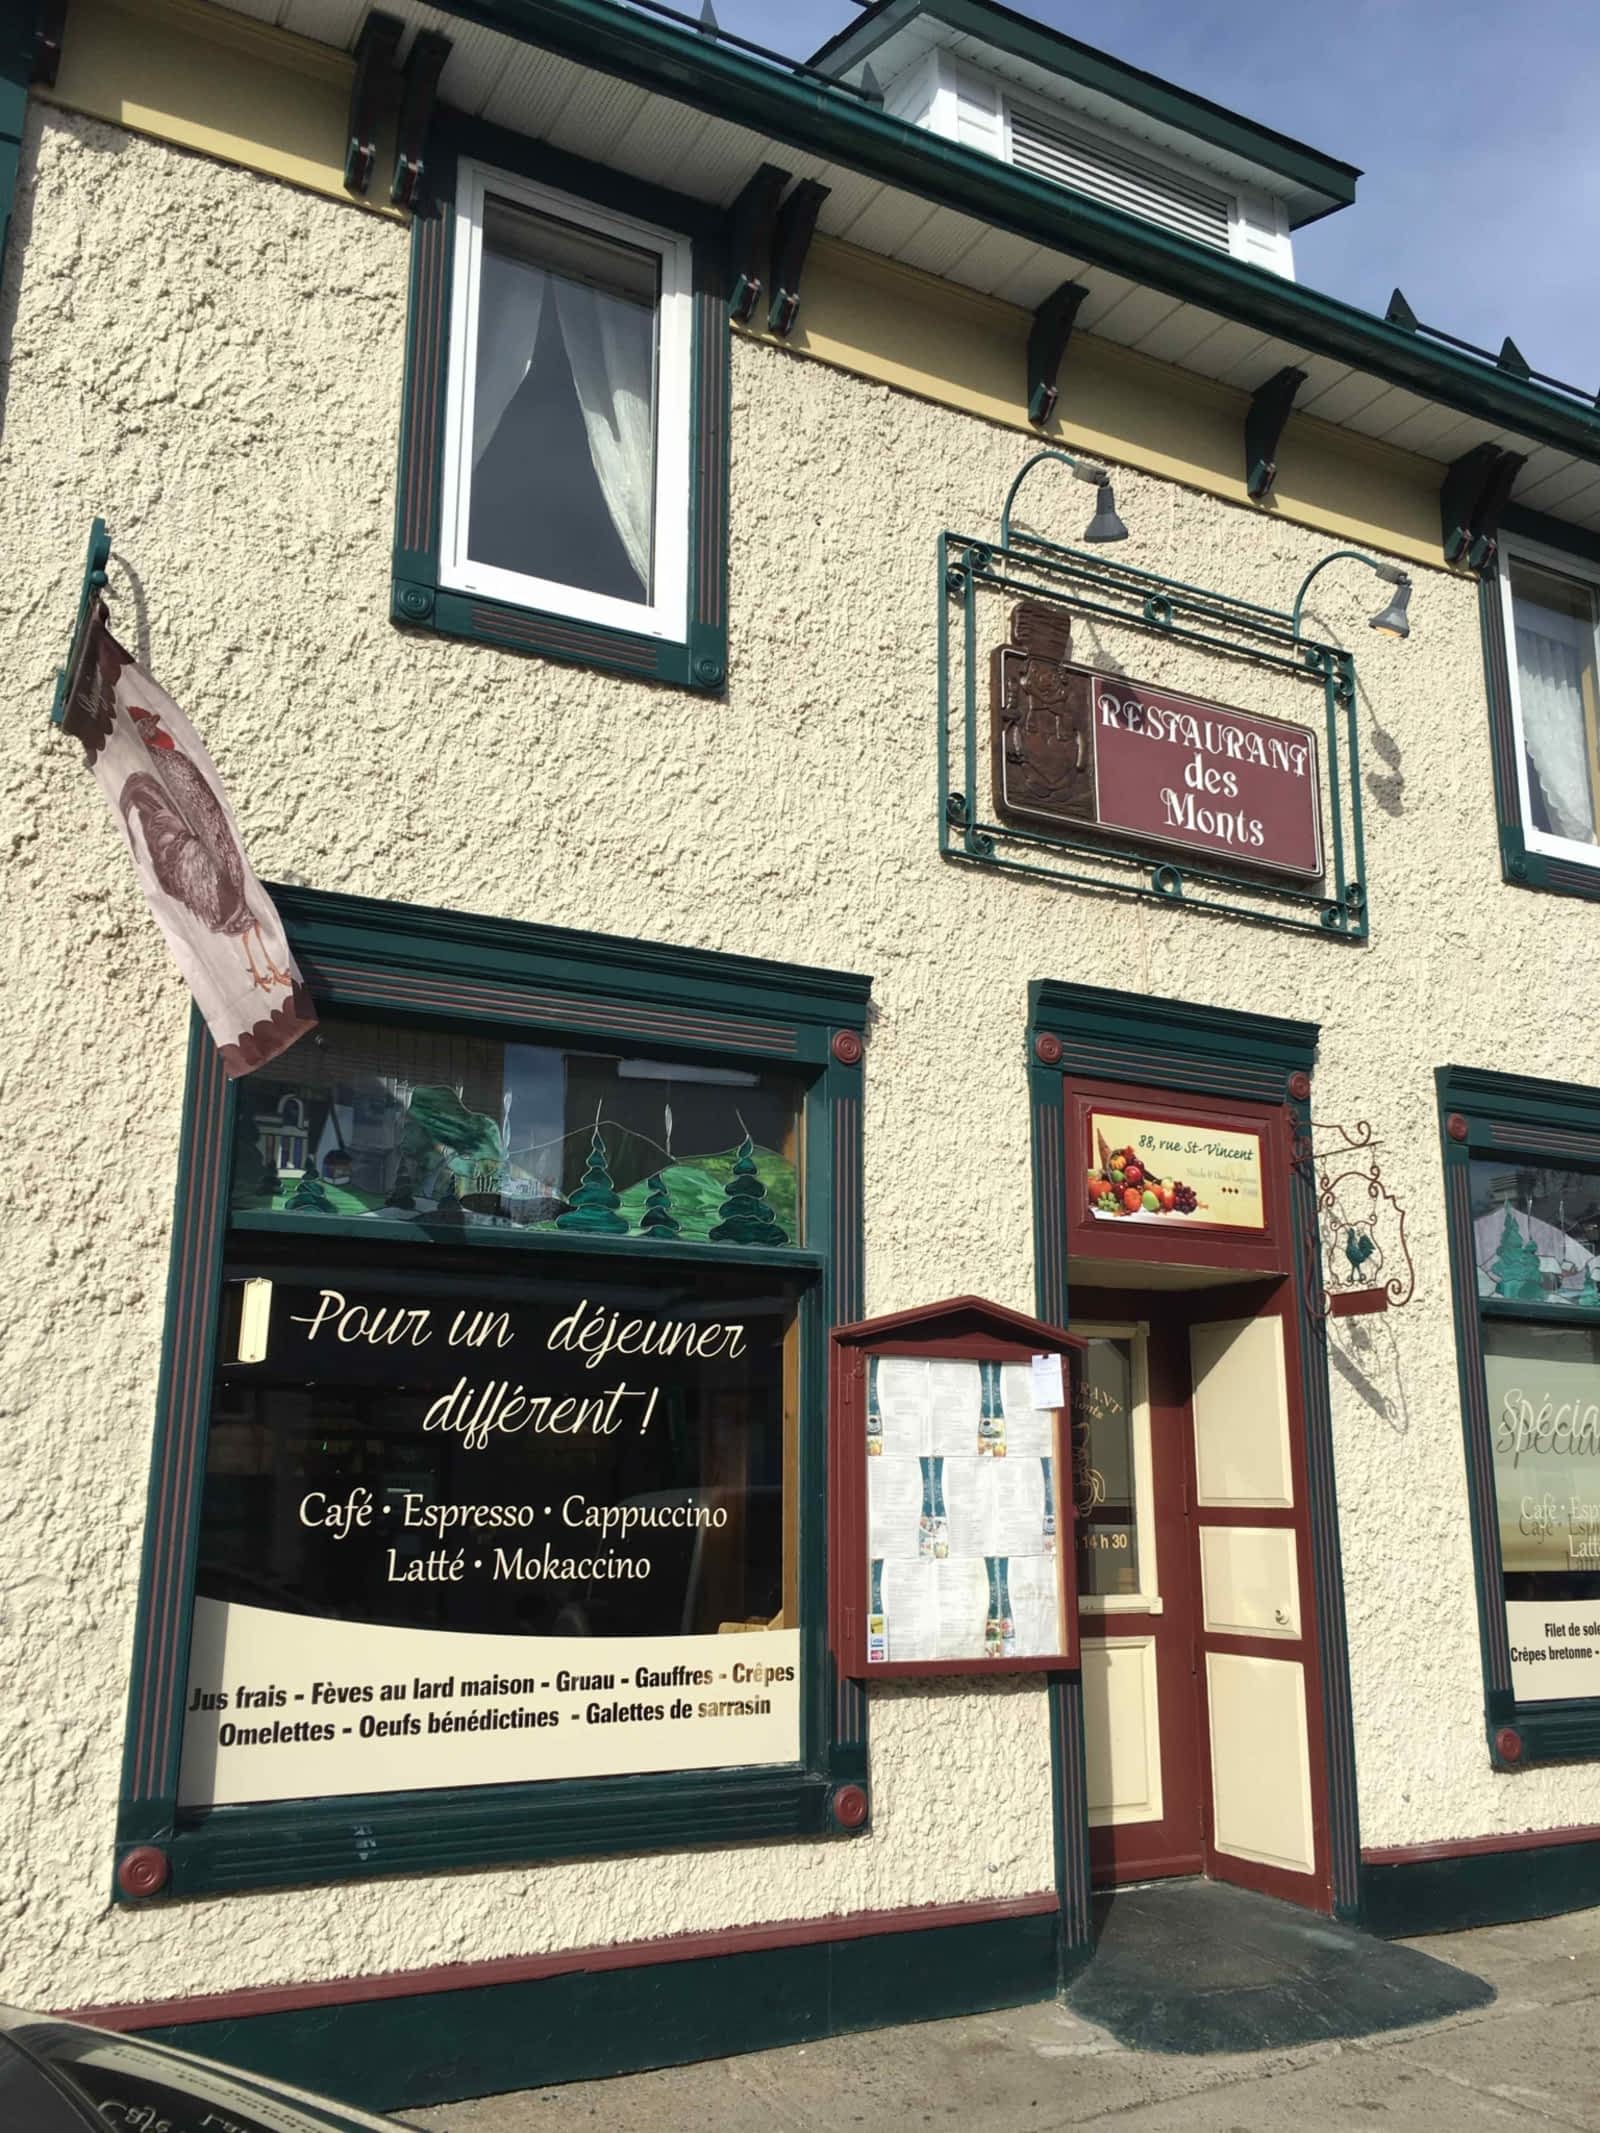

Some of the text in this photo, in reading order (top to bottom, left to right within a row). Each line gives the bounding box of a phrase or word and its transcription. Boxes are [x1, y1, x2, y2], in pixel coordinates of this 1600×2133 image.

[1098, 694, 1308, 777] RESTAURANT
[1184, 753, 1238, 798] des
[1160, 788, 1264, 847] Monts
[1160, 1139, 1182, 1152] rue
[1184, 1140, 1255, 1160] St-Vincent
[290, 1290, 746, 1368] Pour un déjeuner
[300, 1487, 372, 1540] Café
[403, 1494, 534, 1538] Espresso
[562, 1495, 728, 1542] Cappuccino
[1568, 1495, 1600, 1529] Esp
[1112, 1533, 1128, 1549] 30
[1568, 1534, 1600, 1557] Latt
[387, 1547, 465, 1582] Latté
[493, 1543, 651, 1582] Mokaccino
[1544, 1622, 1566, 1637] Filet
[1568, 1622, 1580, 1637] de
[1510, 1645, 1546, 1665] Crêpes
[1549, 1645, 1592, 1660] bretonne
[189, 1687, 228, 1711] Jus
[235, 1685, 287, 1709] frais
[311, 1682, 373, 1705] Fèves
[379, 1684, 406, 1701] au
[413, 1676, 454, 1699] lard
[460, 1674, 535, 1697] maison
[556, 1670, 615, 1692] Gruau
[635, 1665, 713, 1688] Gauffres
[732, 1662, 795, 1687] Crêpes
[219, 1721, 335, 1747] Omelettes
[359, 1713, 421, 1738] Oeufs
[427, 1707, 559, 1733] bénédictines
[586, 1701, 664, 1724] Galettes
[670, 1698, 692, 1719] de
[698, 1695, 771, 1717] sarrasin
